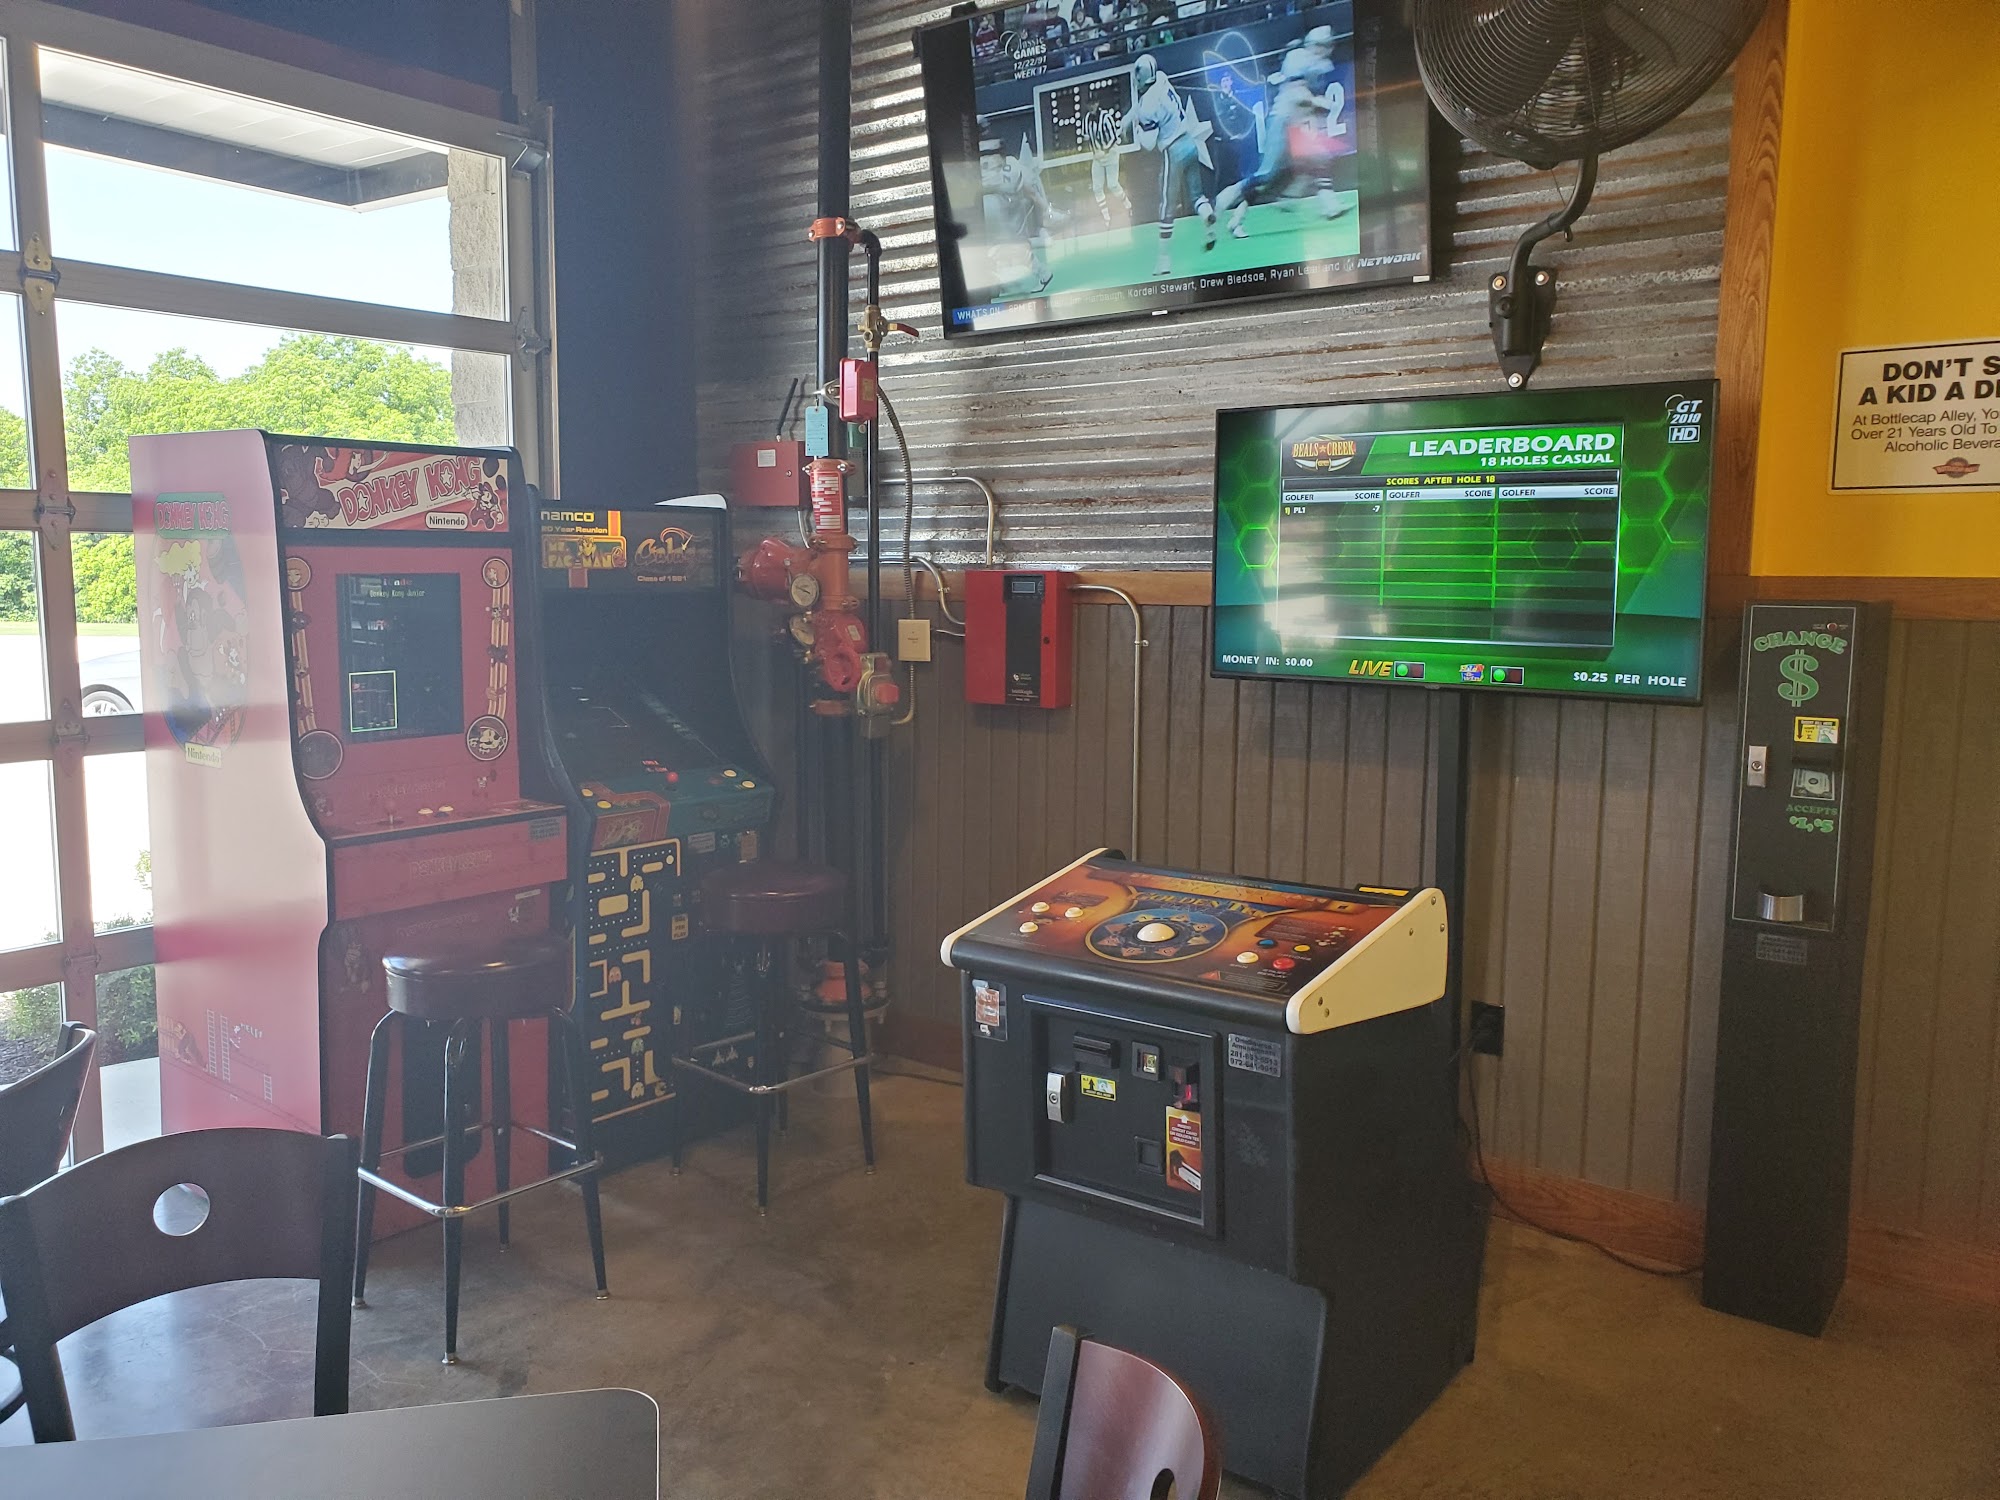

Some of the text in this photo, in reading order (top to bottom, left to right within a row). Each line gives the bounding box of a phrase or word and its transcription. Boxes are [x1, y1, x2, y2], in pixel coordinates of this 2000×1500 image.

[1013, 43, 1047, 60] GAMES
[1013, 55, 1047, 71] 12/22/91
[1014, 65, 1047, 80] WEEK 17
[1357, 251, 1422, 269] NETWORK
[956, 308, 988, 321] WHAT'S
[1127, 284, 1158, 299] Kordell
[1160, 280, 1197, 295] Stewart,
[1200, 277, 1224, 288] Drew
[1227, 272, 1267, 285] Bledsoe,
[1270, 268, 1295, 280] Ryan
[1322, 261, 1340, 272] and
[1882, 358, 1974, 382] DON'T
[1858, 387, 1879, 406] A
[1887, 383, 1937, 404] KID
[1944, 382, 1965, 401] A
[1676, 400, 1703, 413] GT
[1852, 415, 1868, 426] At
[1871, 412, 1936, 426] Bottlecap
[1939, 409, 1976, 423] Alley,
[1671, 427, 1698, 441] HD
[1851, 422, 1998, 440] Over 21 Years Old To
[1292, 440, 1355, 458] BEALS CREEK
[1408, 433, 1616, 457] LEADERBOARD
[1884, 439, 1949, 453] Alcoholic
[1480, 452, 1614, 467] 18 HOLES CASUAL
[1386, 474, 1495, 486] SCORES AFTER HOLE 18
[337, 455, 482, 527] DONKEY KONG
[1285, 491, 1380, 502] GOLFER SCORE
[1389, 489, 1492, 499] GOLFER SCORE
[1502, 486, 1615, 497] GOLFER SCORE
[156, 500, 229, 531] DONKEY KONG
[429, 515, 466, 527] Nintendo
[540, 511, 595, 523] namco
[555, 525, 575, 533] Year
[575, 526, 608, 534] Reunion
[1753, 630, 1848, 655] CHANGE
[1222, 655, 1313, 667] MONEY IN: $0.00
[1348, 659, 1394, 676] LIVE
[1573, 671, 1687, 687] $0.25 PER HOLE
[1777, 648, 1819, 708] $
[1785, 804, 1838, 816] ACCEPTS
